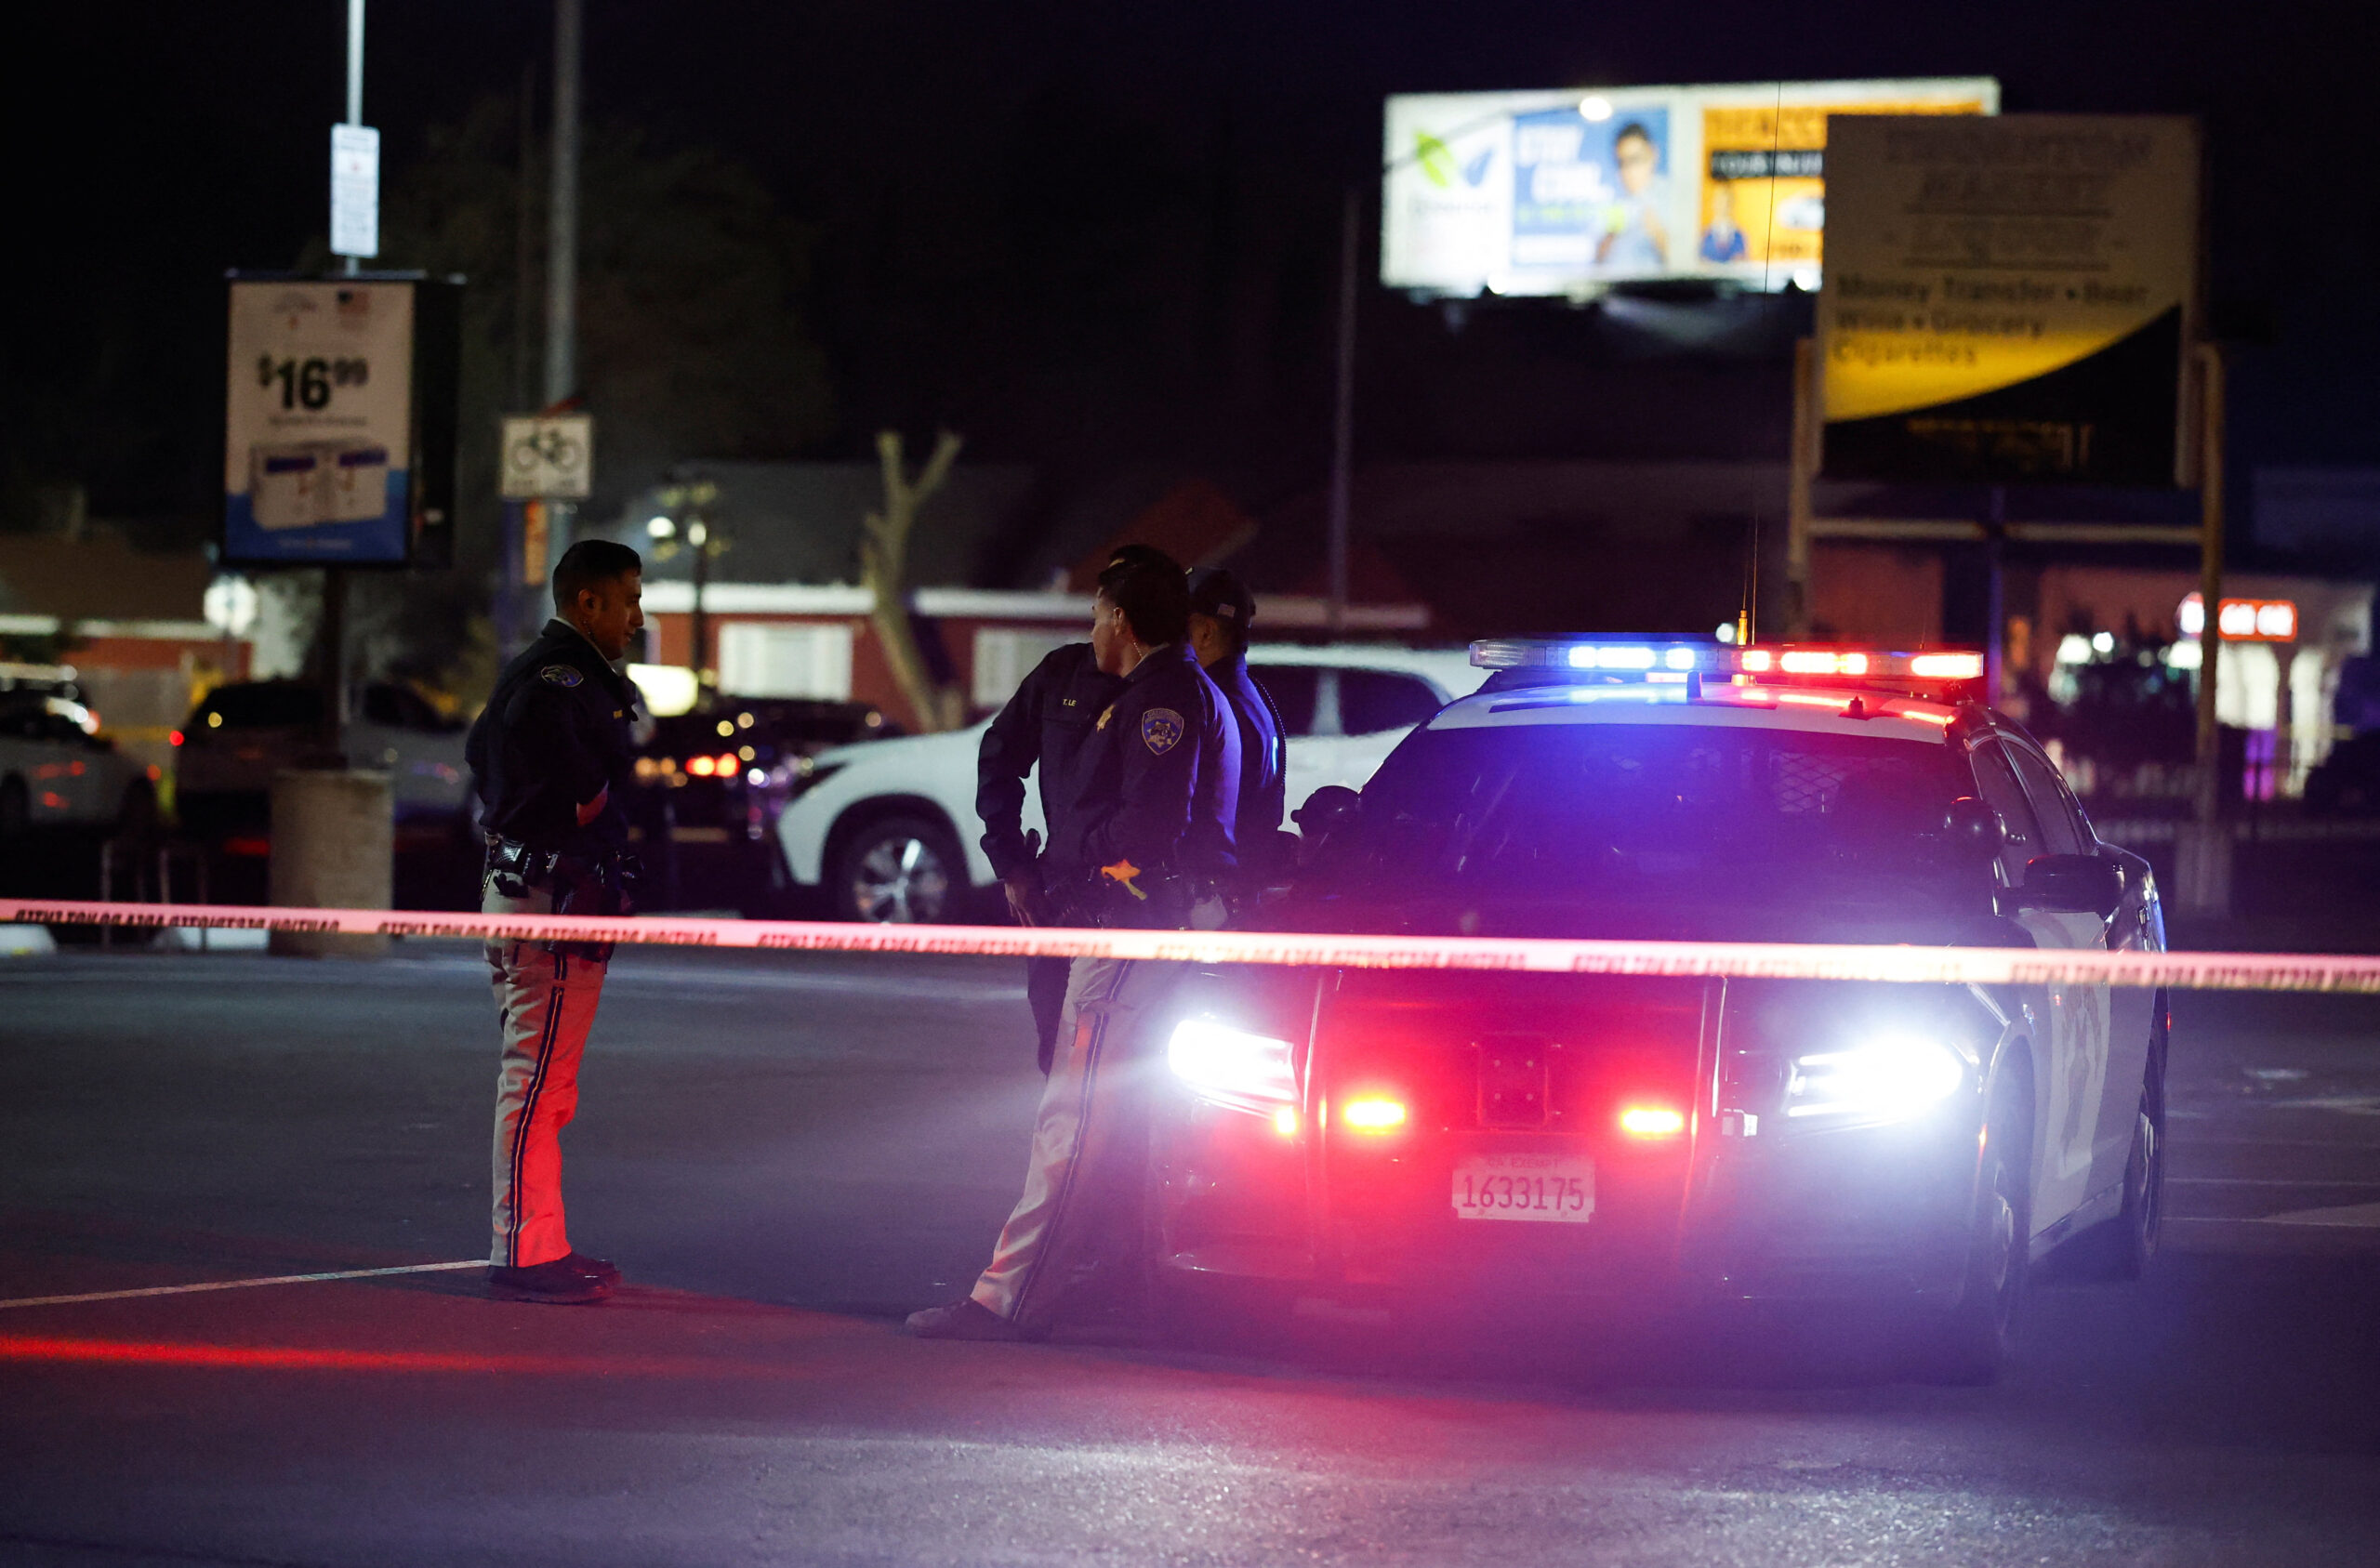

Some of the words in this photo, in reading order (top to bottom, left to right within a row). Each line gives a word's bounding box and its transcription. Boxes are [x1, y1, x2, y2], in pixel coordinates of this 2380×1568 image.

[1836, 275, 1930, 302] Money
[1943, 276, 2055, 302] Transfer
[1461, 1175, 1585, 1212] 1633175
